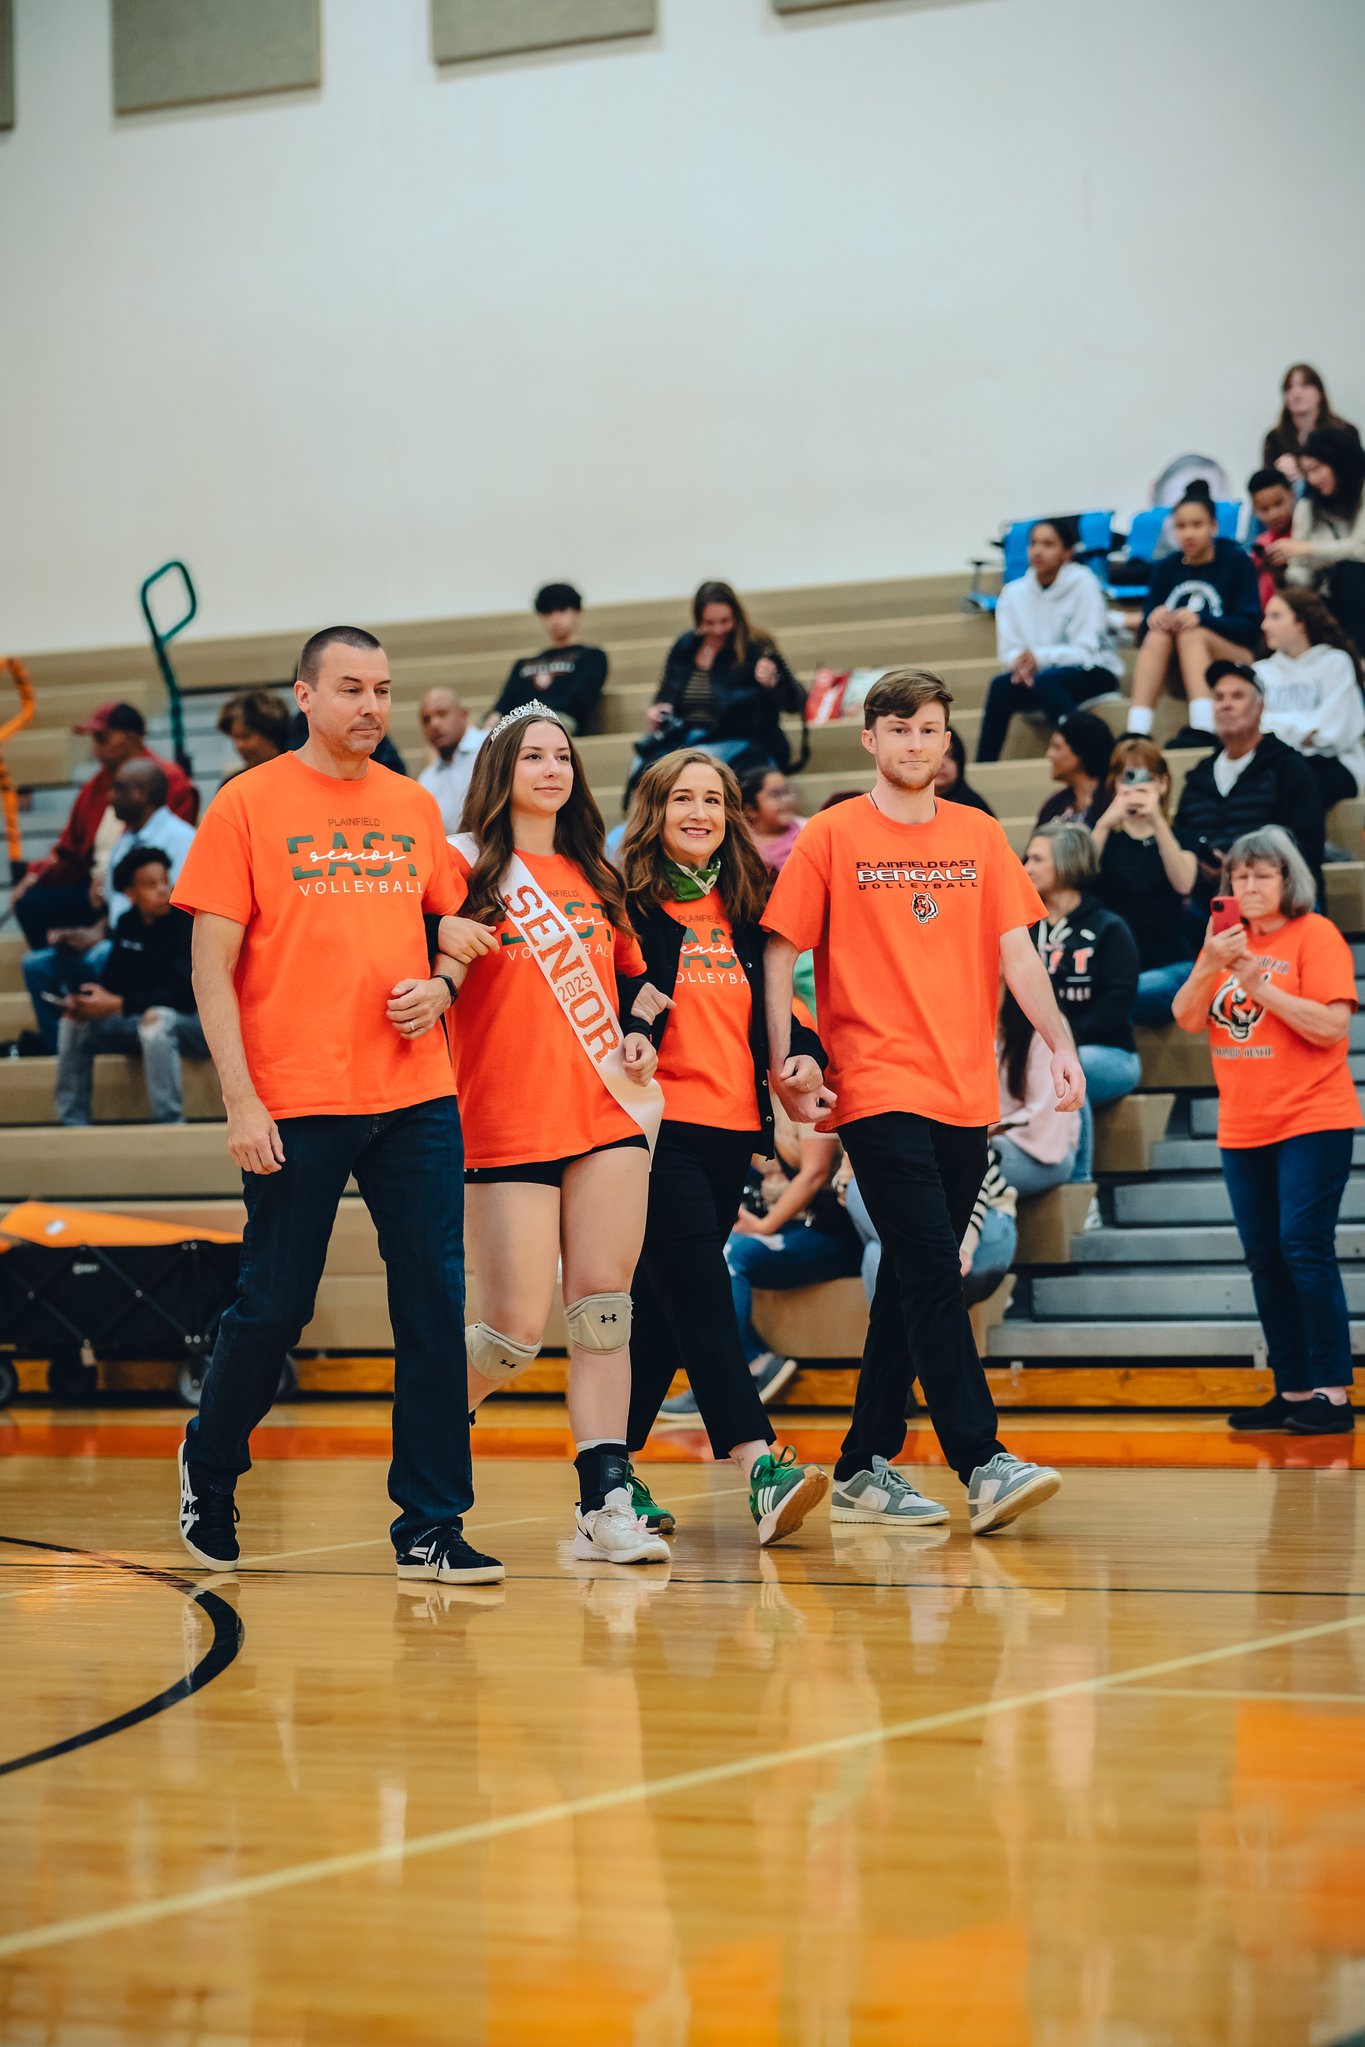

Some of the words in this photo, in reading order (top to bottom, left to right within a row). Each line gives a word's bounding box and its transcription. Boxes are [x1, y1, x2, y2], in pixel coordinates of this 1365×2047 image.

[328, 817, 380, 827] PLAINFIELD
[287, 832, 417, 880] EAST
[310, 849, 406, 862] senior
[856, 861, 938, 869] PLAINFIELD
[939, 860, 976, 868] EAST
[857, 867, 978, 883] BENGALS
[299, 880, 423, 897] VOLLEYBALL
[858, 882, 978, 890] VOLLEYBALL
[678, 914, 721, 925] PLAINFIELD
[680, 944, 738, 957] enior
[676, 971, 750, 985] OLLEYBA
[558, 971, 593, 1002] 2025
